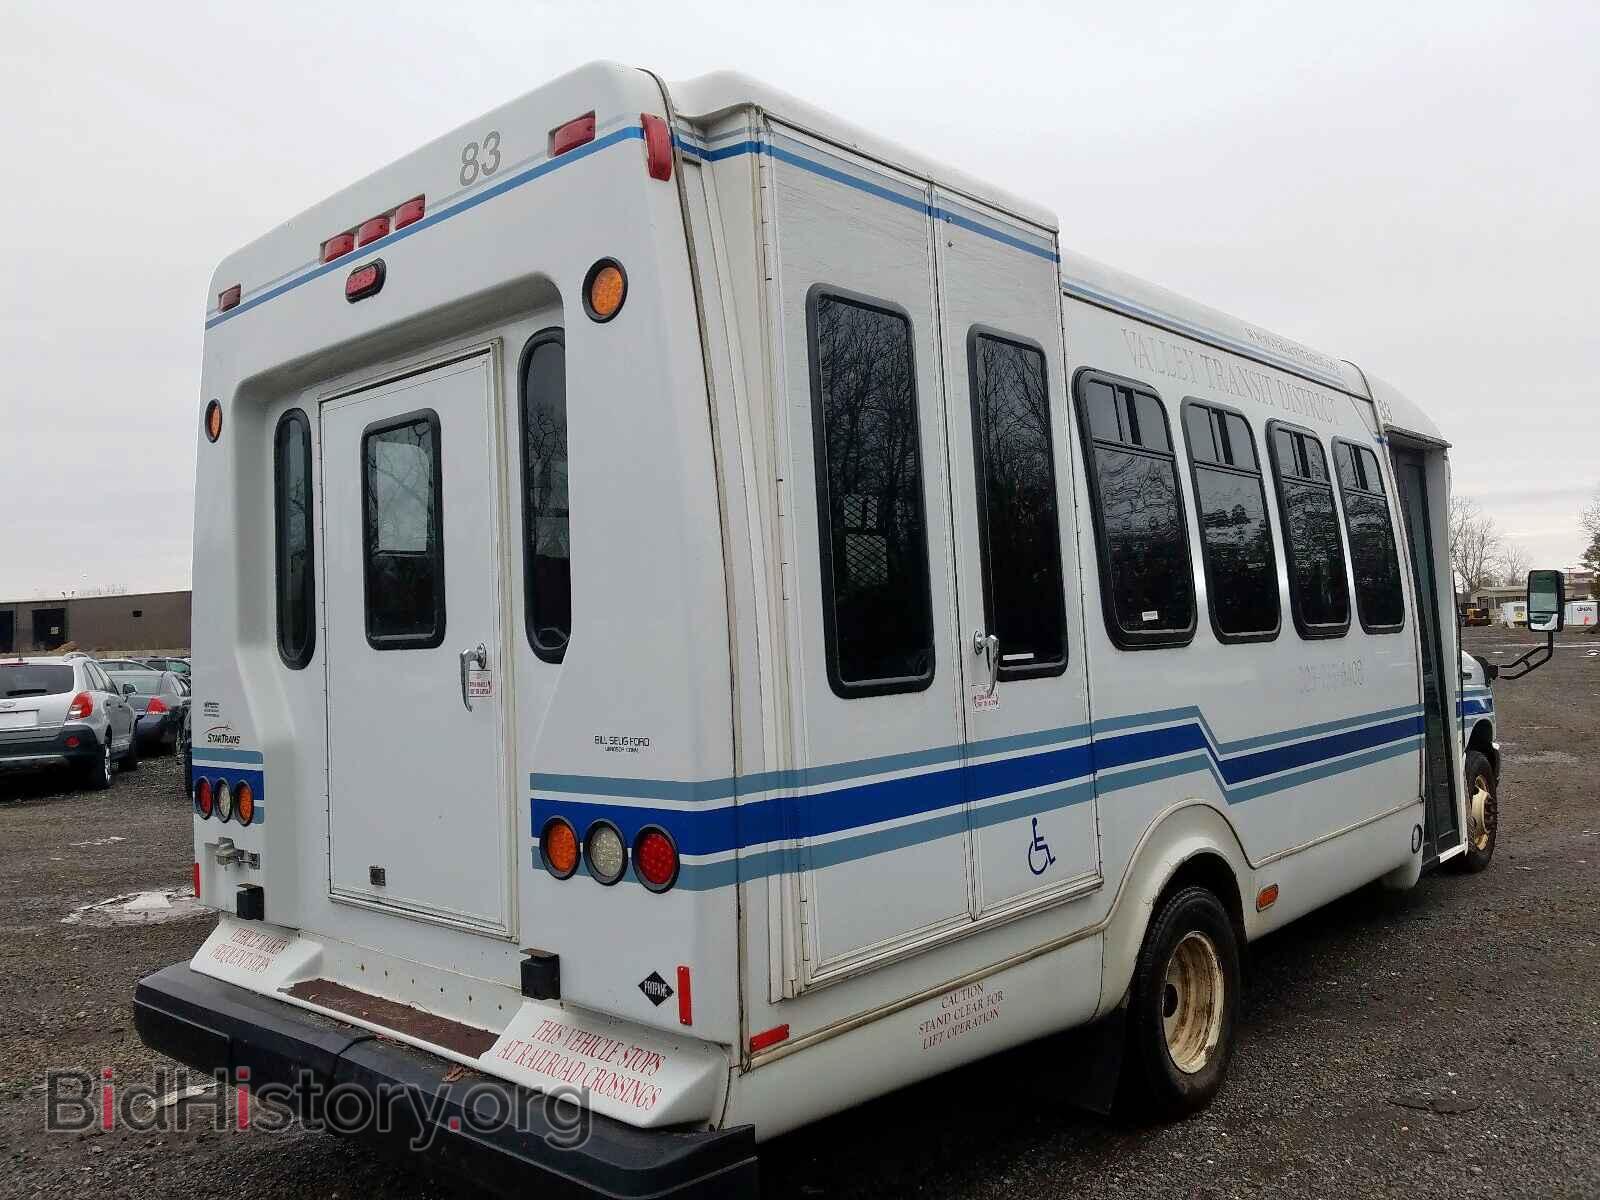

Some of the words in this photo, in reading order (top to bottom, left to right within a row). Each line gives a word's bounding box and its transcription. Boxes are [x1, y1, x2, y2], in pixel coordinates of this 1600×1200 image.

[460, 130, 500, 186] 83
[1121, 328, 1199, 384] VALLEY
[1201, 354, 1274, 406] TRANSIT
[1277, 379, 1340, 425] DISTRICT
[629, 737, 650, 747] FORD
[643, 980, 668, 998] PROPANE
[941, 983, 984, 1009] CAUTION
[919, 1013, 951, 1035] STAND
[954, 999, 984, 1021] CLEAR
[986, 990, 1004, 1007] FOR
[923, 1031, 945, 1050] LIFT
[946, 1008, 1000, 1040] OPERATION
[531, 1019, 566, 1044] THIS
[565, 1029, 624, 1063] VEHICLE
[616, 1044, 667, 1077] STOPS
[497, 1040, 522, 1062] AT
[515, 1045, 585, 1083] RAILROAD
[581, 1066, 662, 1111] CROSSINGS
